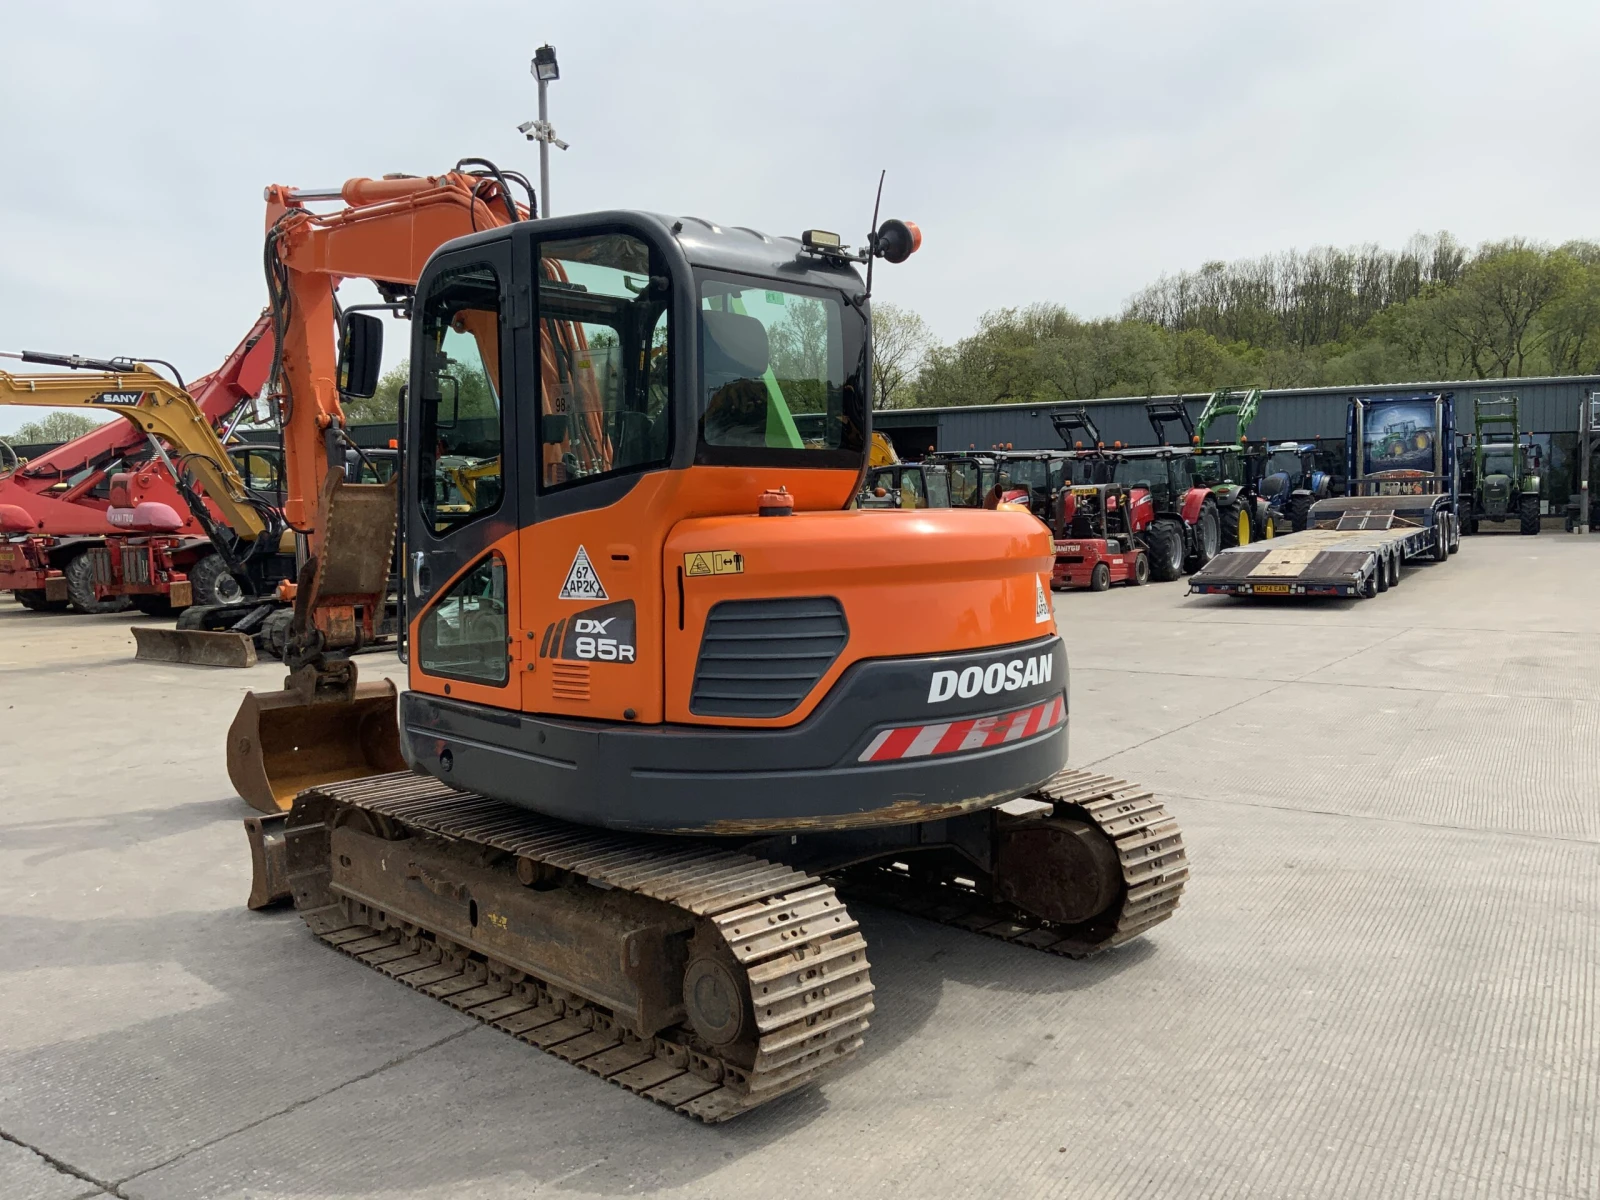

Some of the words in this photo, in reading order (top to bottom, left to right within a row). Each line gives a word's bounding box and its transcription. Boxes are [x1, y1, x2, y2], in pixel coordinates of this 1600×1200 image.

[103, 394, 137, 403] SANY
[555, 398, 566, 412] 98
[576, 567, 589, 579] 67
[570, 580, 596, 593] AP2K
[575, 617, 617, 634] DX
[576, 637, 635, 661] 85R
[927, 653, 1053, 703] DOOSAN
